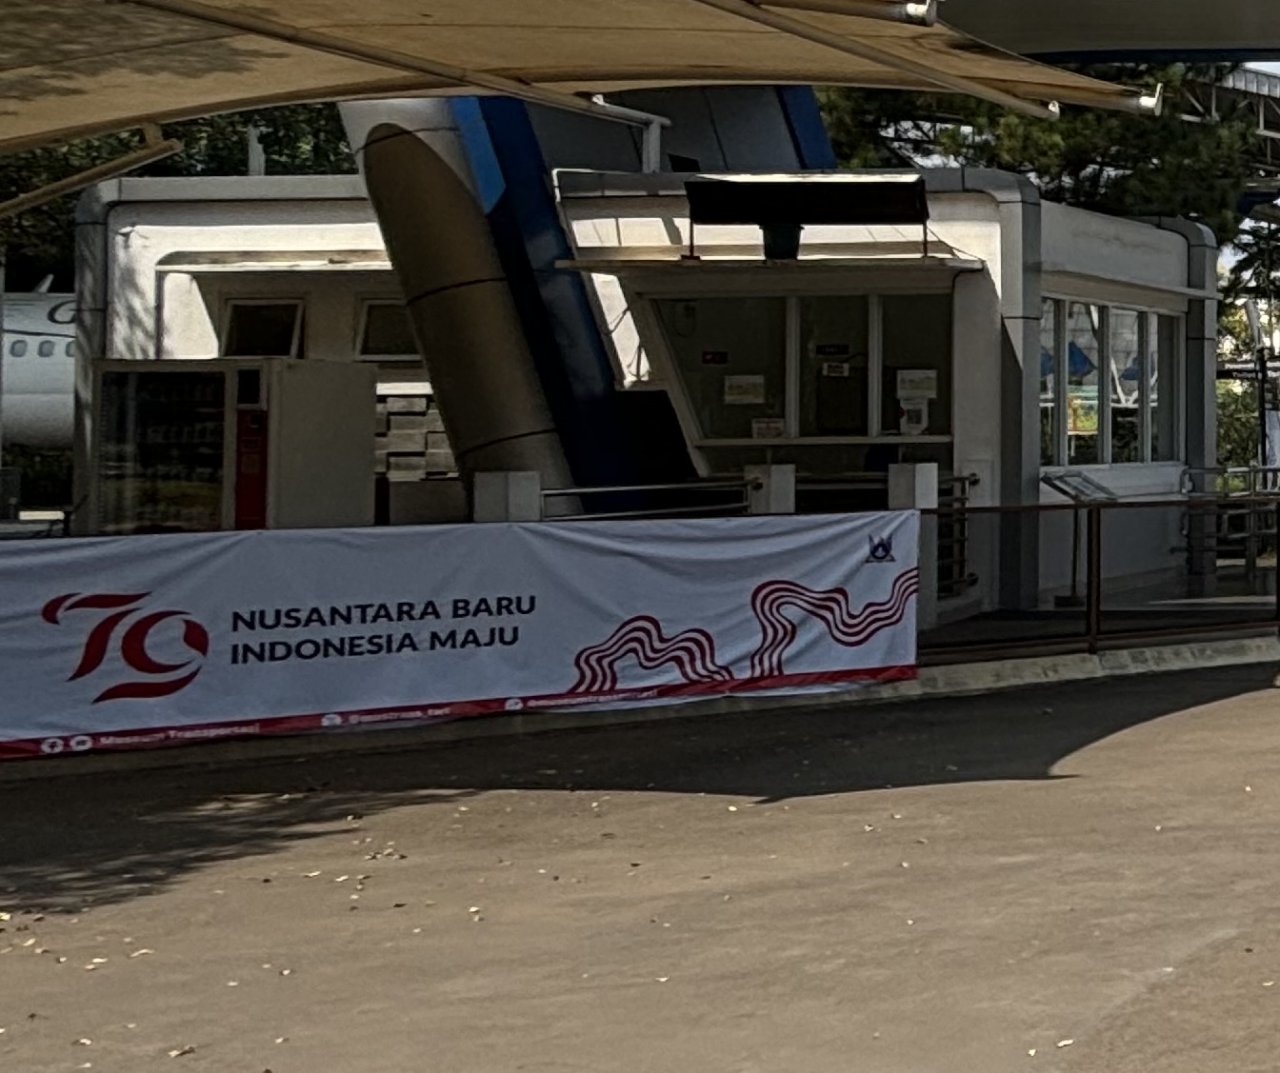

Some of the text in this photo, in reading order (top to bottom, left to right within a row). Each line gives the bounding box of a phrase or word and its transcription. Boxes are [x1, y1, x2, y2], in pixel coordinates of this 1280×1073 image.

[231, 595, 536, 632] NUSANTARA BARU
[230, 626, 519, 665] INDONESIA MAJU
